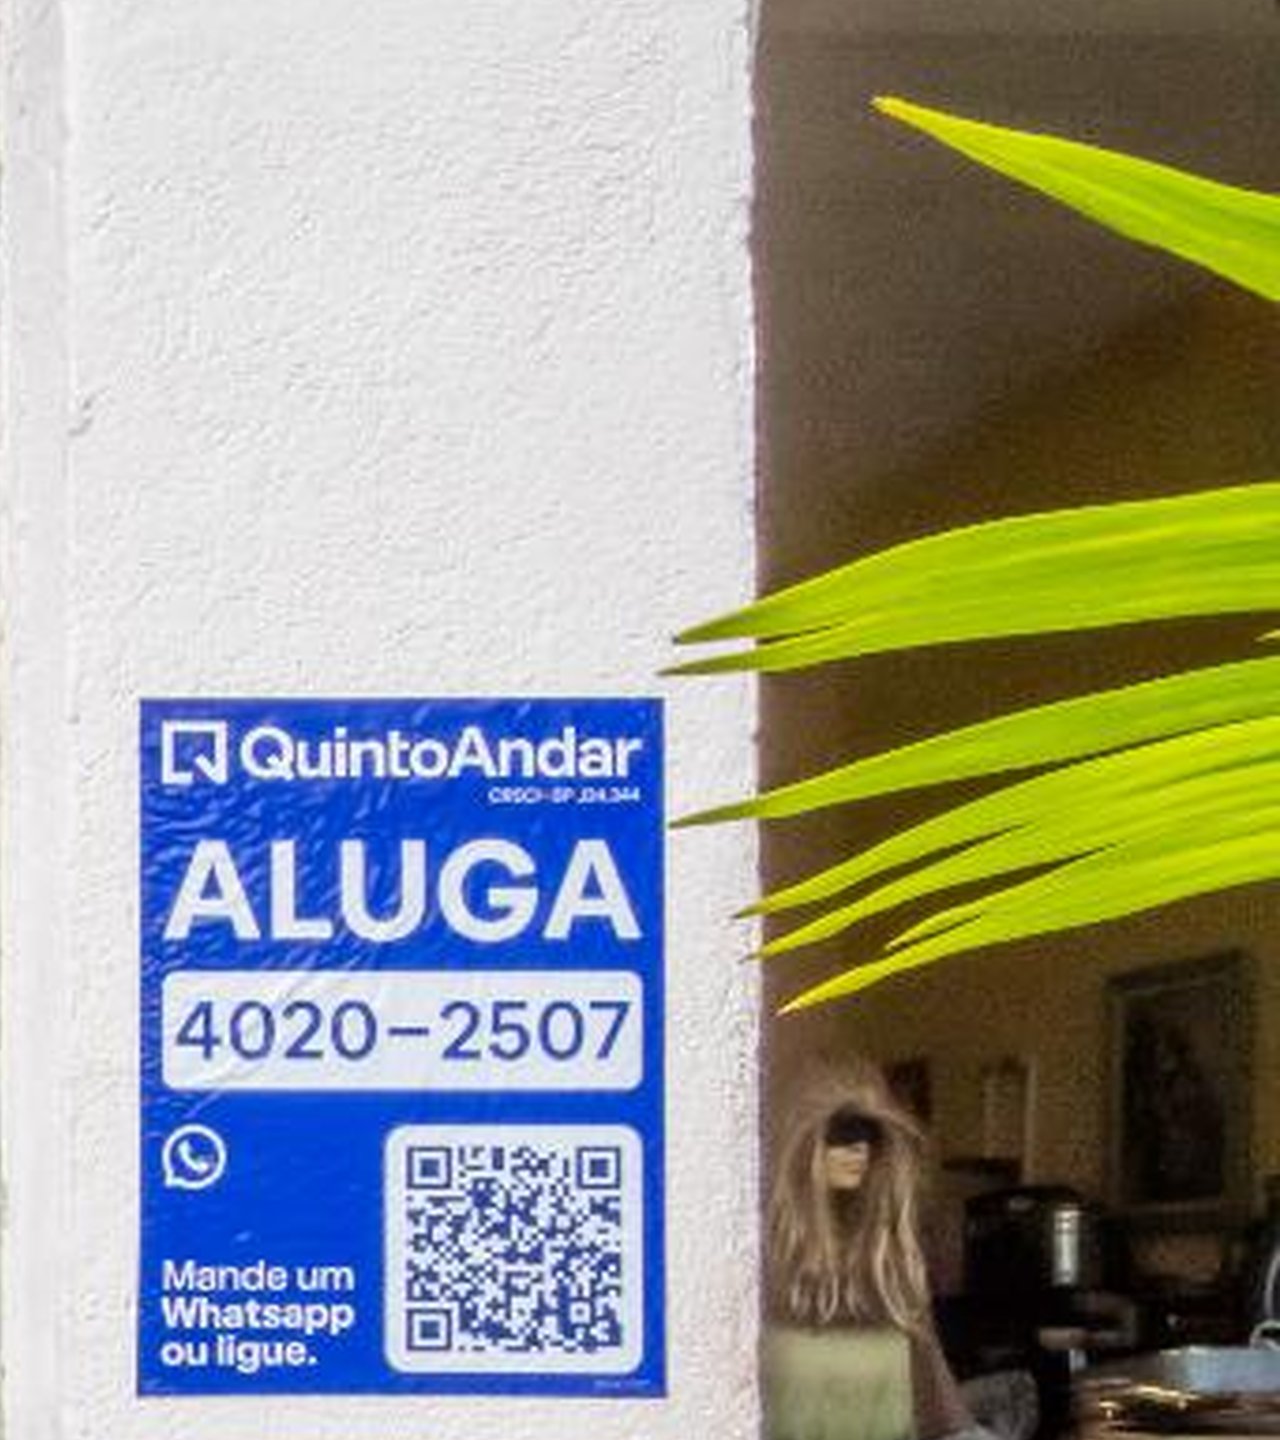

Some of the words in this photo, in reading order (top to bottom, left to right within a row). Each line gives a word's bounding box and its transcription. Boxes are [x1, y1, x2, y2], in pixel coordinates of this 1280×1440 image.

[239, 724, 643, 782] QuintoAndar
[162, 838, 643, 944] ALUGA
[175, 999, 633, 1062] 4020-2507
[162, 1259, 288, 1292] Mande
[295, 1266, 356, 1292] um
[160, 1295, 356, 1336] Whatsapp
[160, 1340, 209, 1367] ou
[216, 1334, 318, 1375] ligue.
